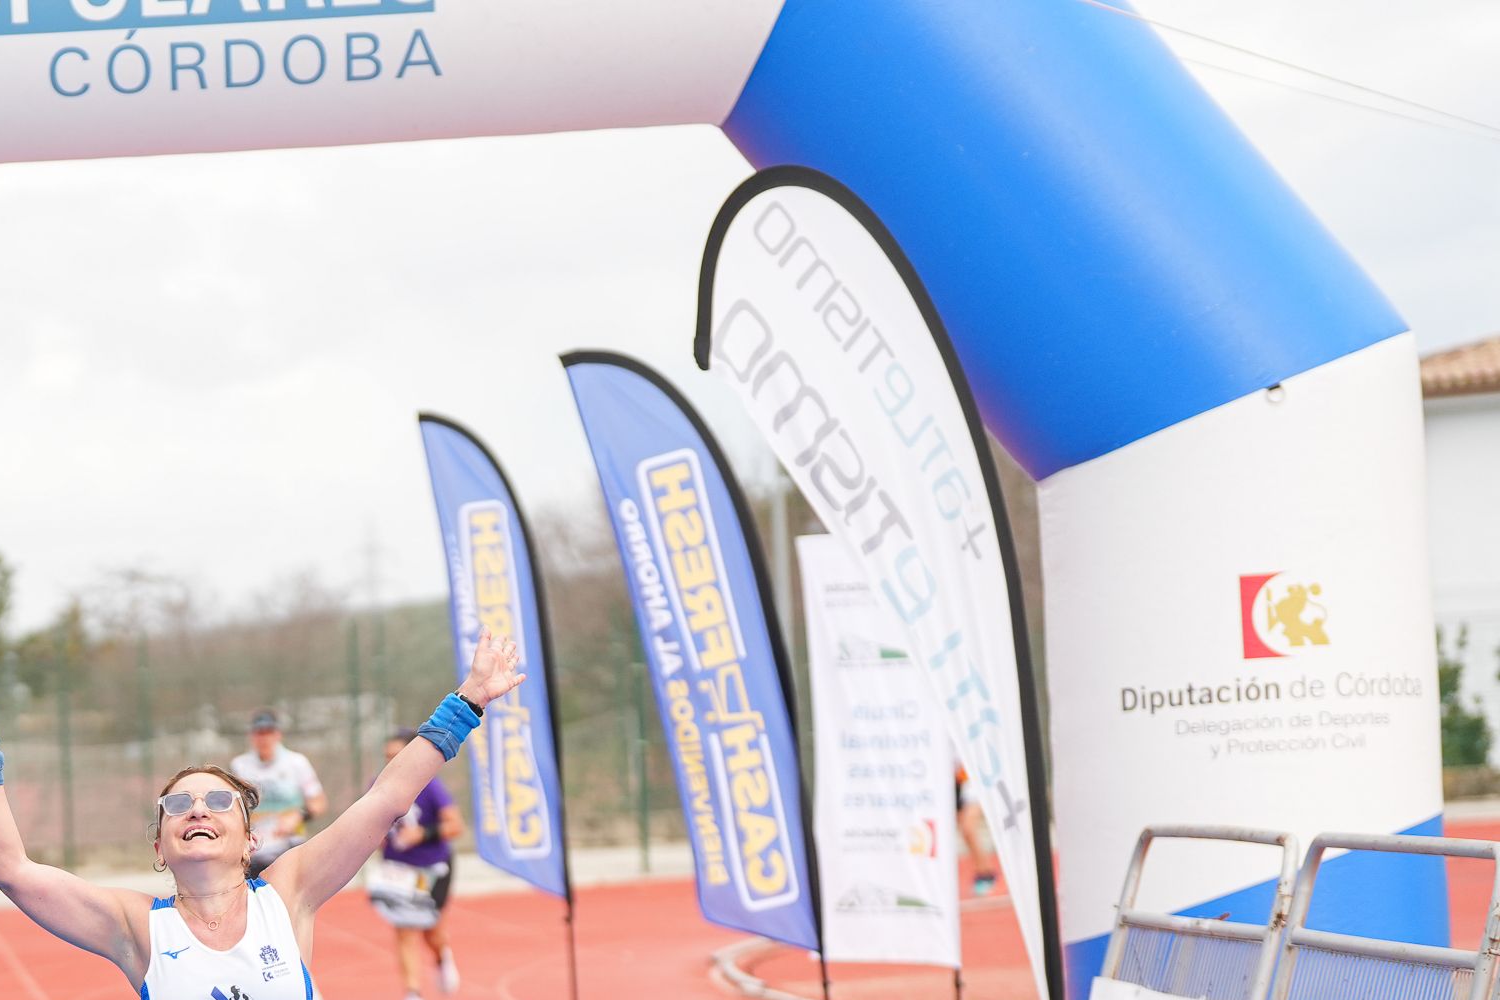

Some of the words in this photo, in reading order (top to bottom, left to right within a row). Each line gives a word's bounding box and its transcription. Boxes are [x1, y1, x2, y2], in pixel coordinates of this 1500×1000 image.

[49, 28, 443, 98] CÓRDOBA
[1120, 676, 1282, 714] Diputación
[1289, 675, 1325, 699] de
